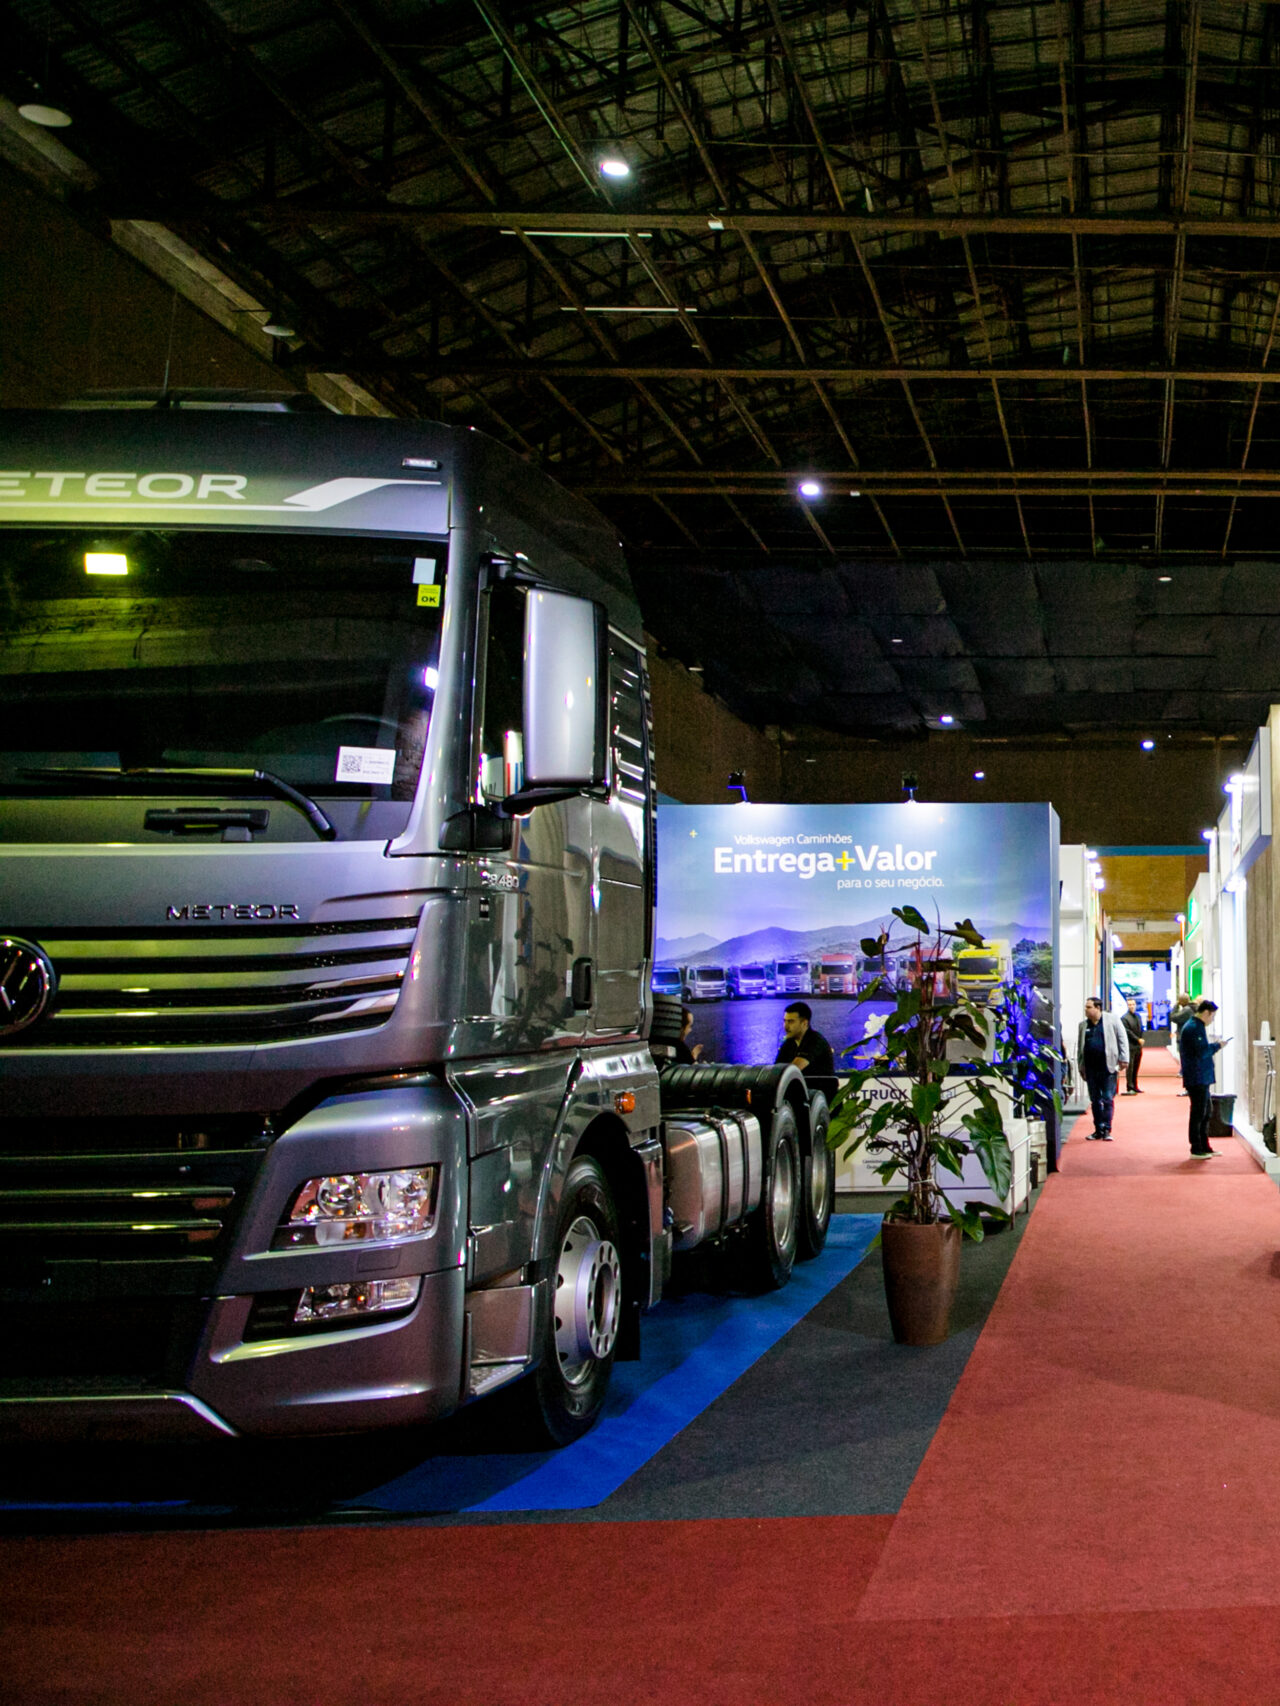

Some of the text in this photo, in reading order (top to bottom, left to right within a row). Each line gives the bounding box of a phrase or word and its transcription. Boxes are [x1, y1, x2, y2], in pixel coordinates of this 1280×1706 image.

[0, 471, 248, 500] ETEOR
[734, 833, 852, 846] Volkswagen Caminhões
[837, 876, 944, 890] para o seu negócio.
[166, 904, 300, 920] METEOR
